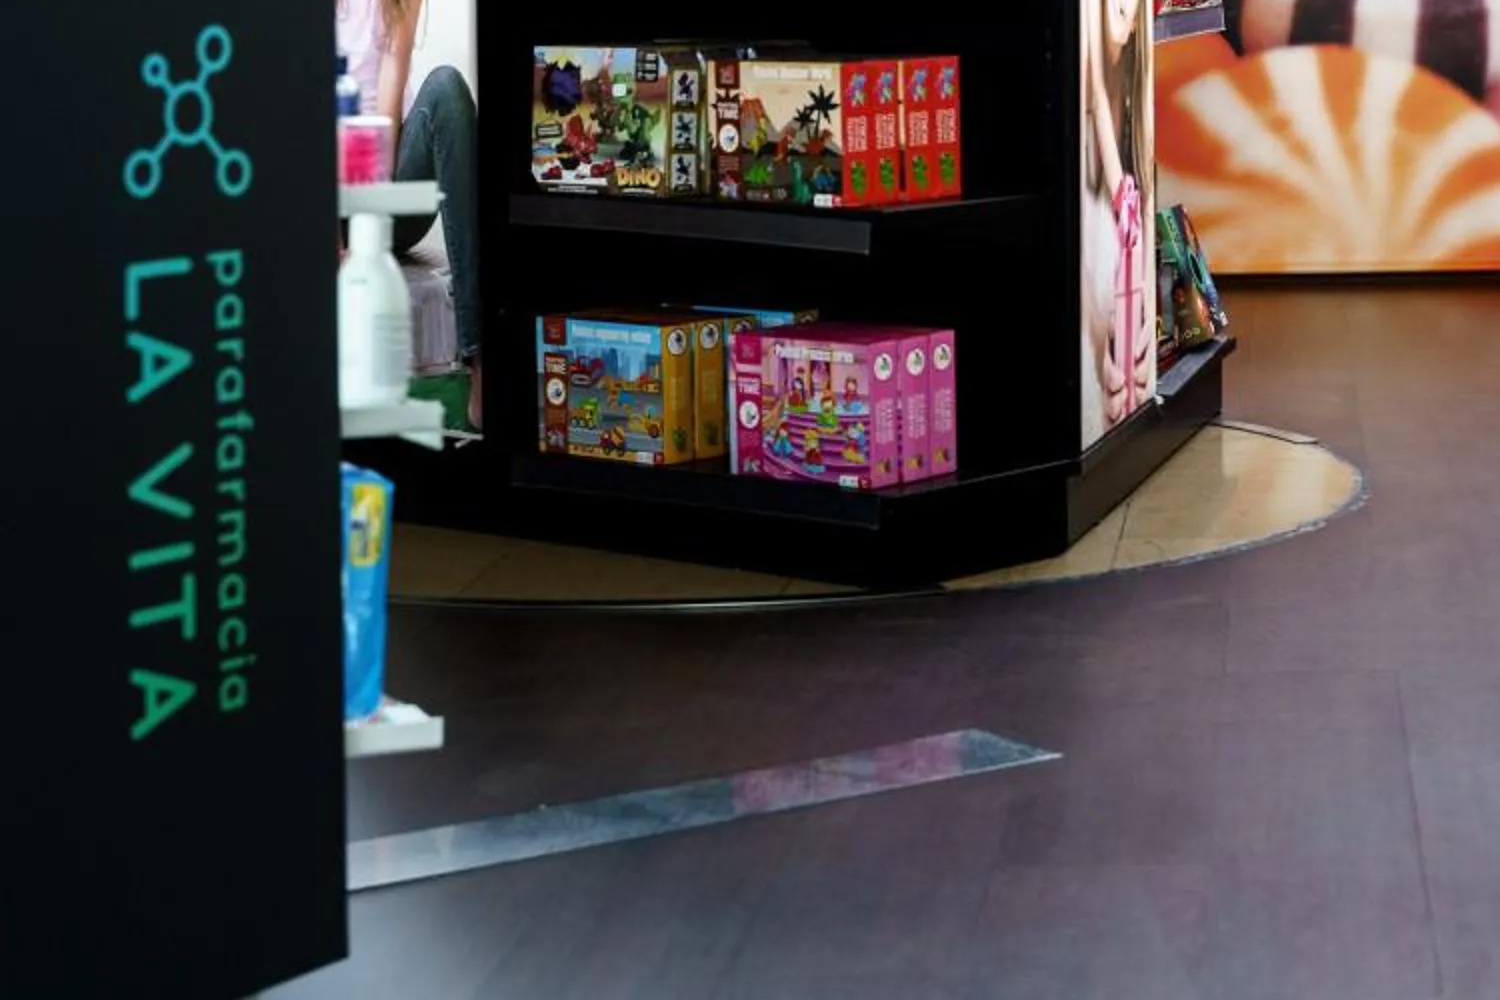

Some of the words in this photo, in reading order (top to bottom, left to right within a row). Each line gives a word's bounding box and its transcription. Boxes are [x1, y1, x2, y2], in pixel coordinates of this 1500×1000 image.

[616, 167, 661, 188] DINO
[124, 257, 193, 403] LA
[128, 441, 196, 741] VITA
[206, 249, 258, 711] parafarmacia
